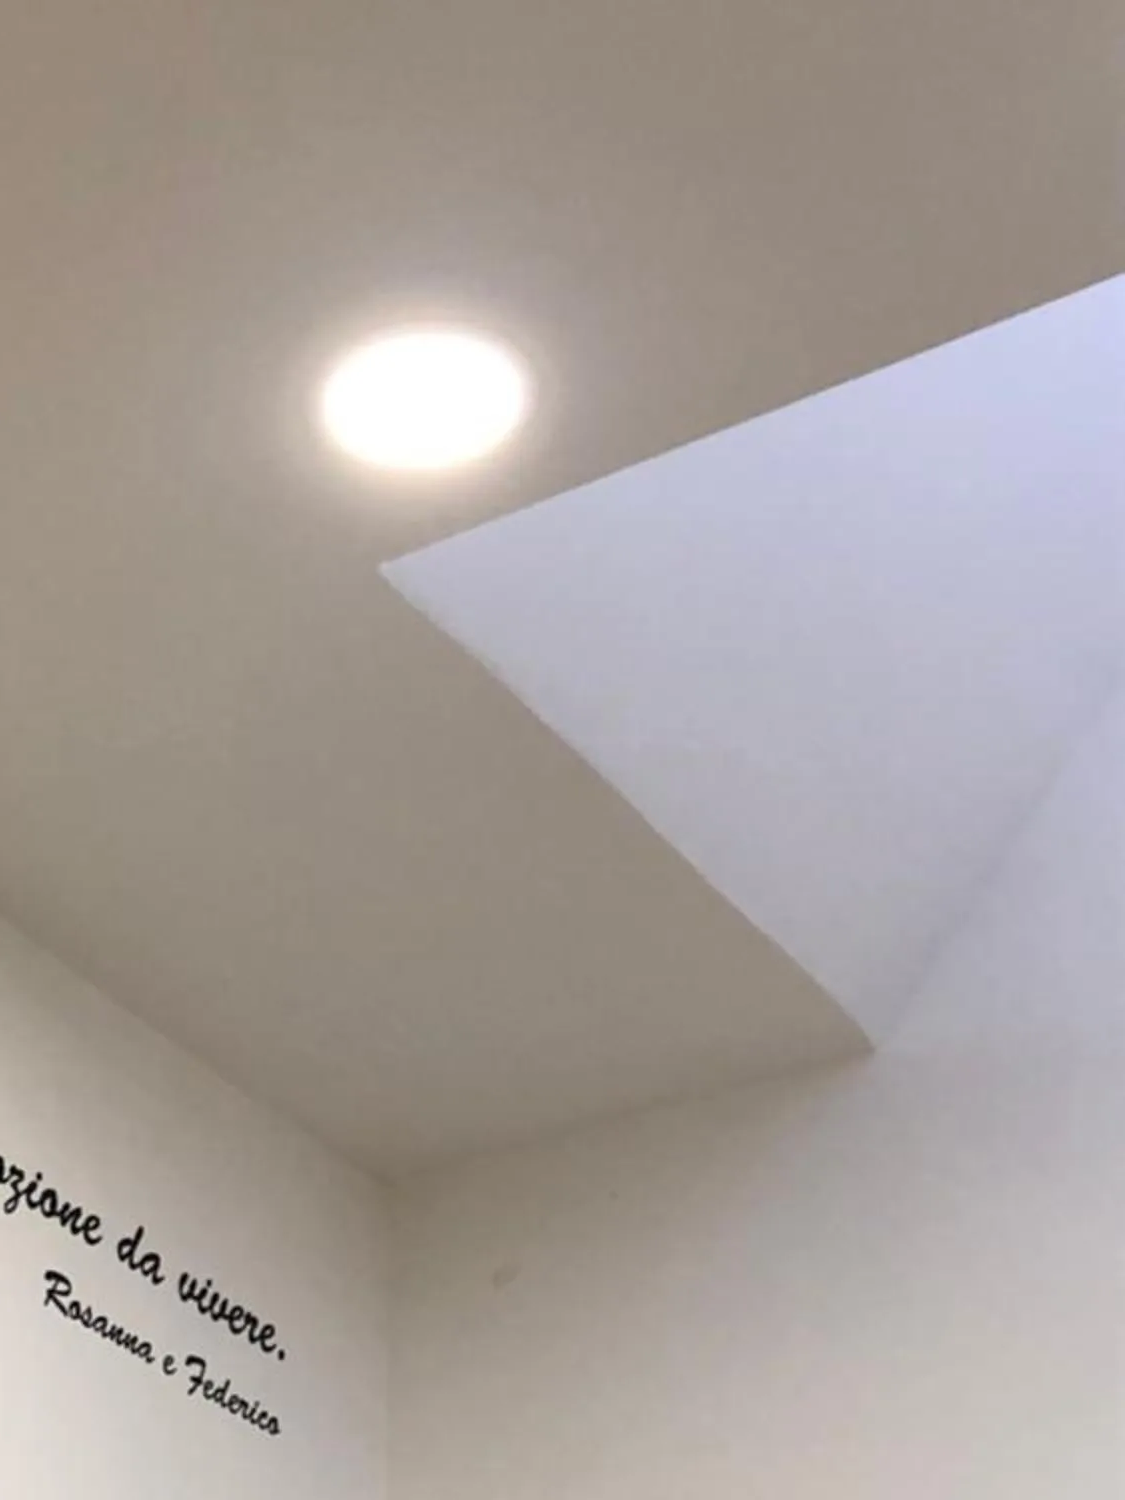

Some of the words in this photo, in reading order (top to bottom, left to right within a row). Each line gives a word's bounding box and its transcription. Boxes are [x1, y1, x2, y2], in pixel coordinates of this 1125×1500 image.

[43, 1269, 156, 1364] Rosanna
[161, 1354, 178, 1376] e
[184, 1355, 281, 1436] Federico
[117, 1226, 165, 1286] da
[178, 1271, 286, 1361] vivere.
